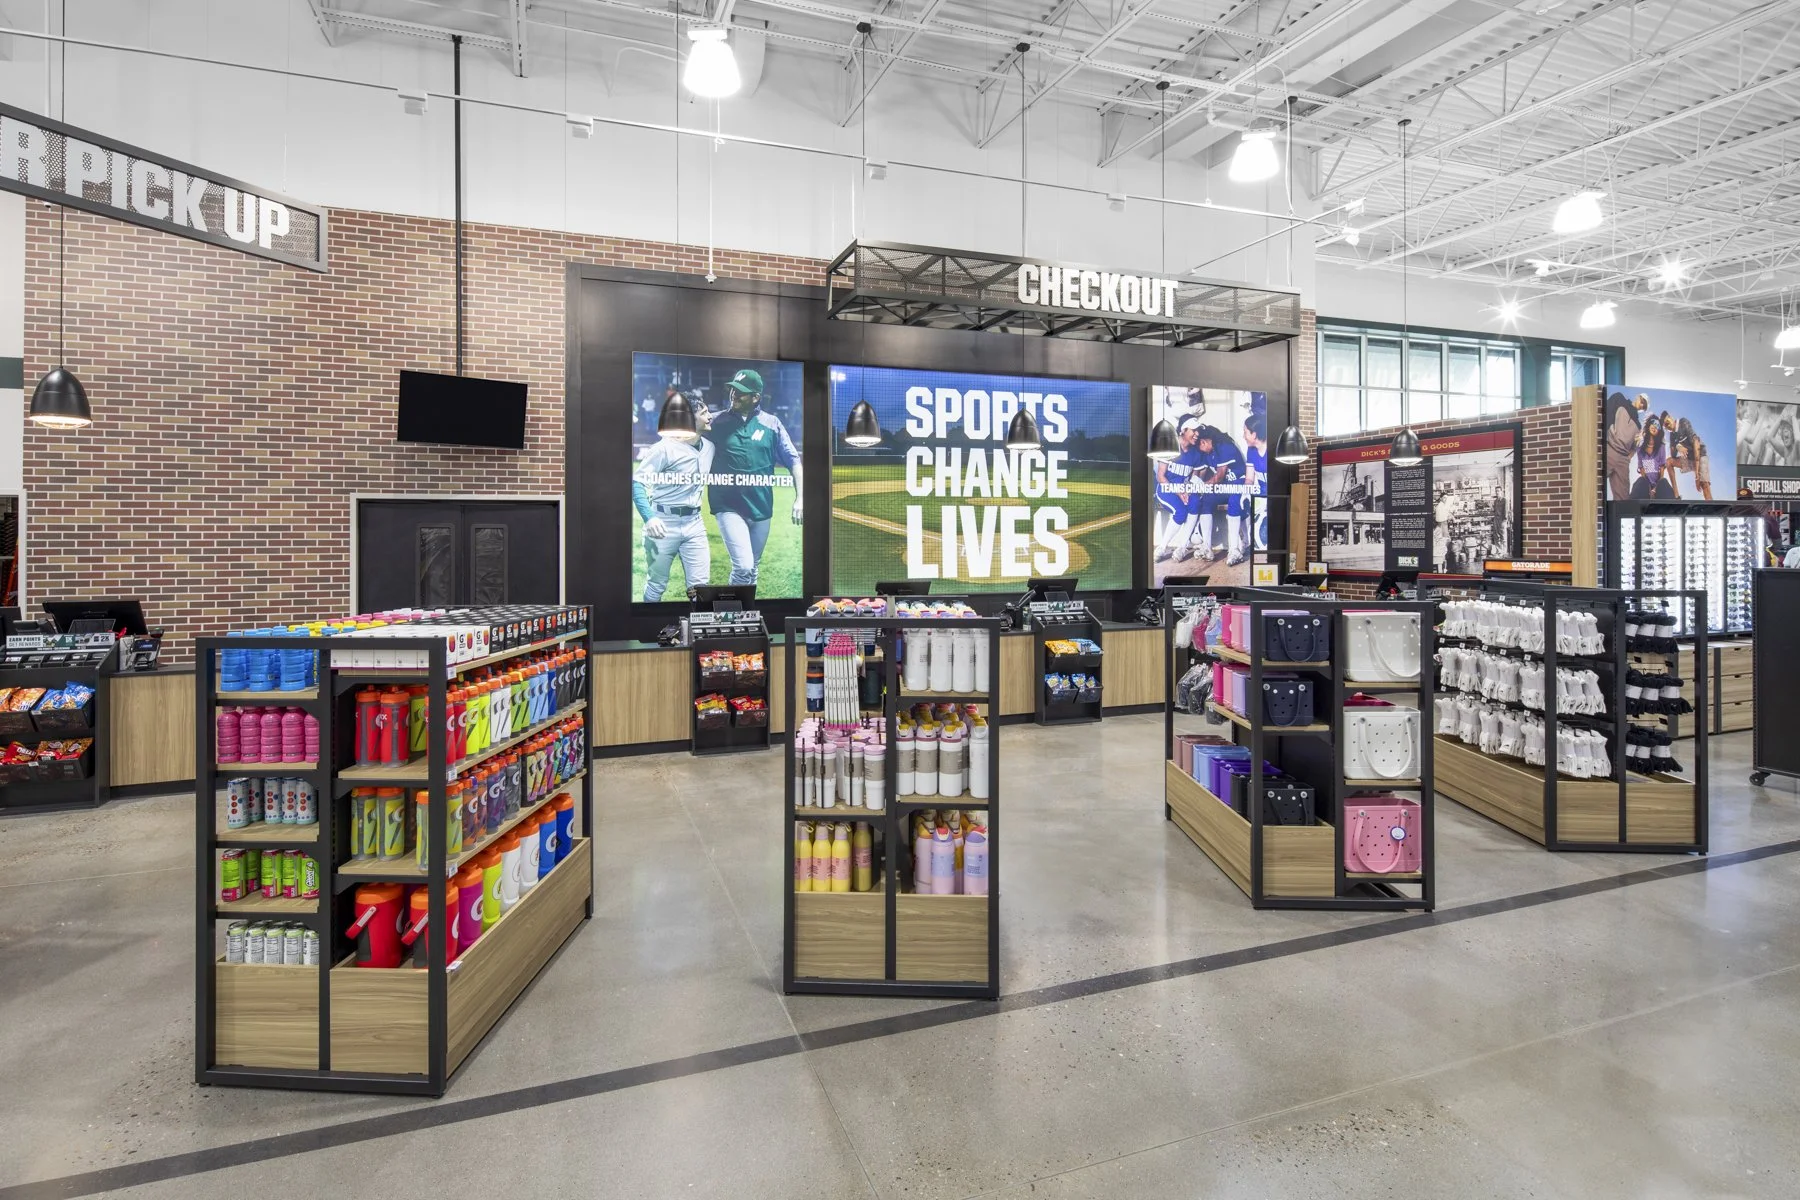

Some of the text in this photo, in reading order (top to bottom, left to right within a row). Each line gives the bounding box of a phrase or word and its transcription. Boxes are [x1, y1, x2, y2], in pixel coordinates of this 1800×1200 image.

[65, 136, 208, 232] PICK
[224, 187, 290, 249] UP
[1018, 263, 1178, 317] CHECKOUT
[1430, 441, 1460, 450] GOODS
[644, 472, 794, 487] COACHES CHANGE CHARACTER
[905, 446, 1068, 499] CHANGE
[1160, 483, 1261, 494] TEAMS CHANGE COMMUNITIES
[1747, 480, 1800, 493] SOFTBALL SHOP
[906, 505, 1070, 579] LIVES
